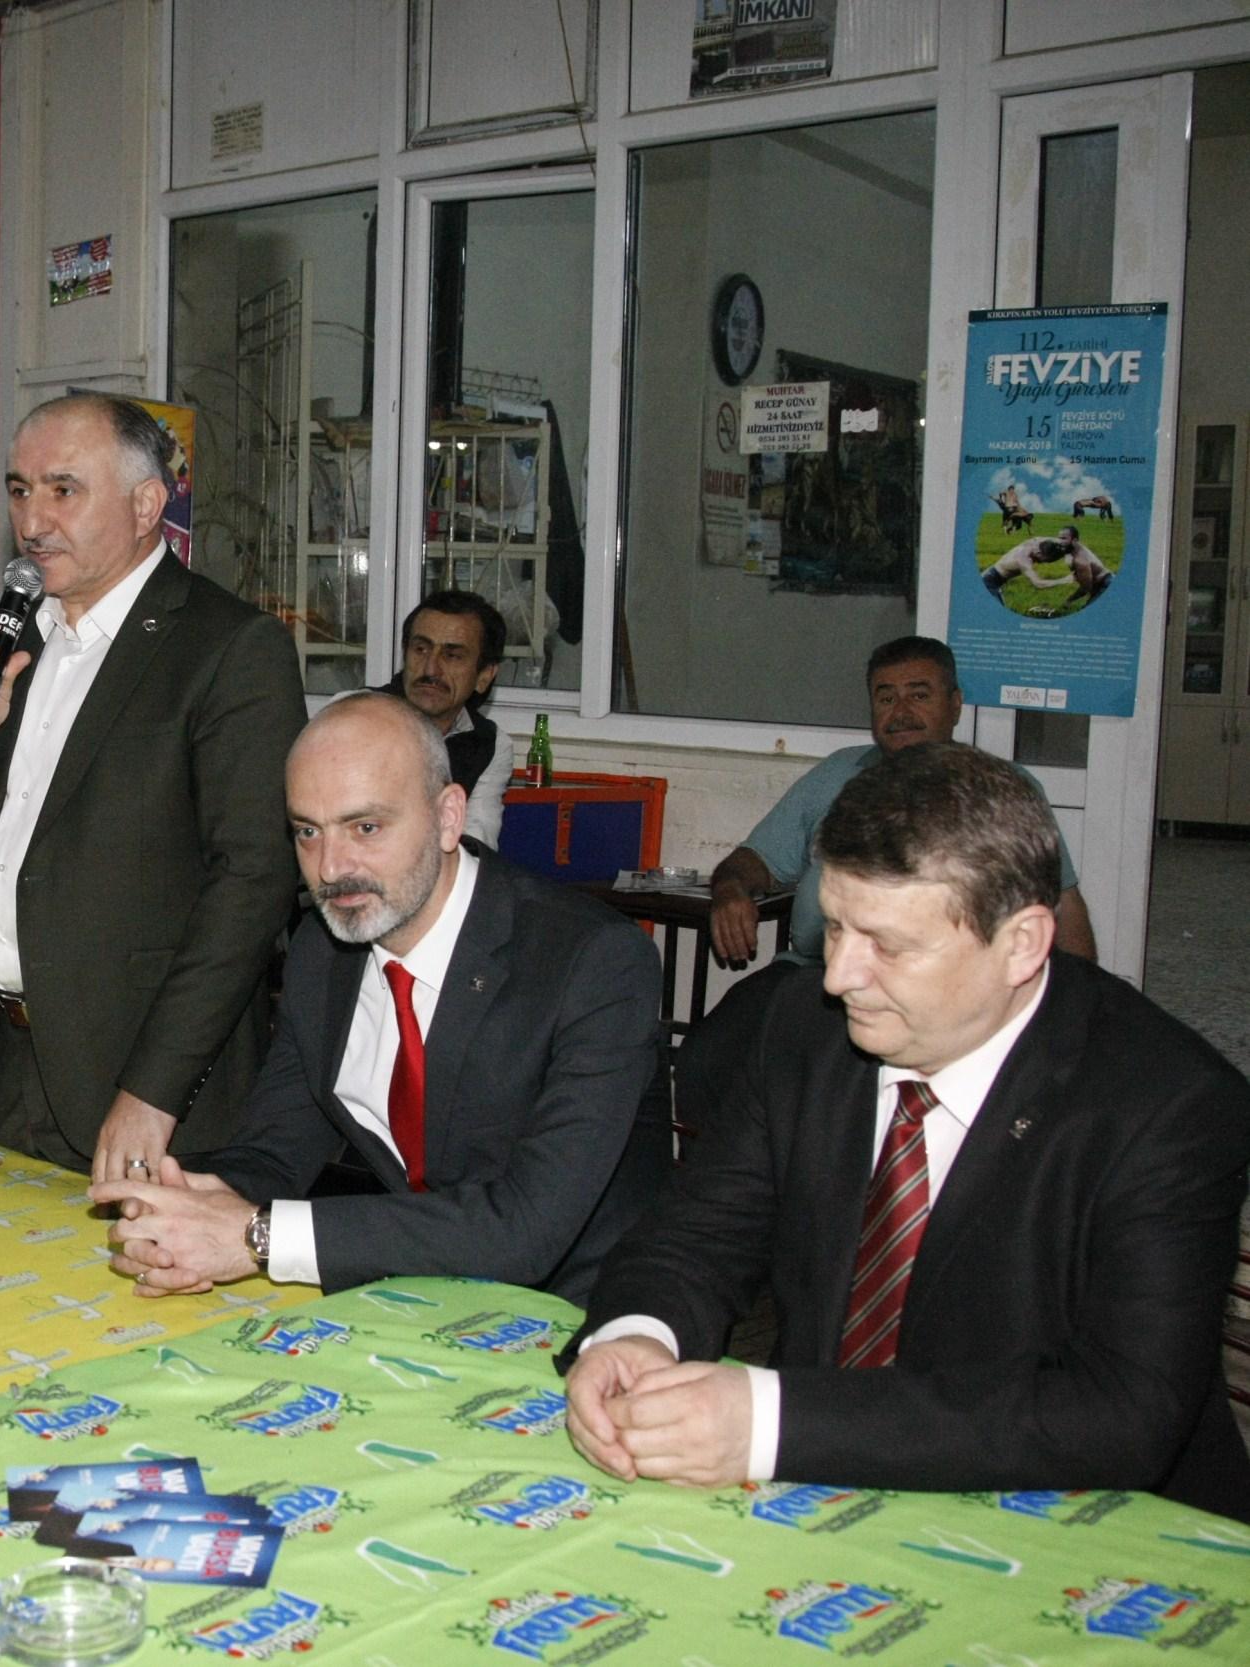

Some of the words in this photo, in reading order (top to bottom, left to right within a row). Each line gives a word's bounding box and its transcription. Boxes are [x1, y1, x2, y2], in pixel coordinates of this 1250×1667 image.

[1043, 307, 1065, 317] YOLU
[1019, 331, 1064, 351] 112.
[766, 385, 806, 396] MUHTAR
[755, 399, 784, 410] RECEP
[786, 397, 817, 408] GÜNAY
[766, 412, 778, 421] 24
[780, 411, 803, 421] SAAT
[1025, 415, 1051, 438] 15
[1060, 441, 1096, 450] YALOVA
[1069, 455, 1081, 465] 15
